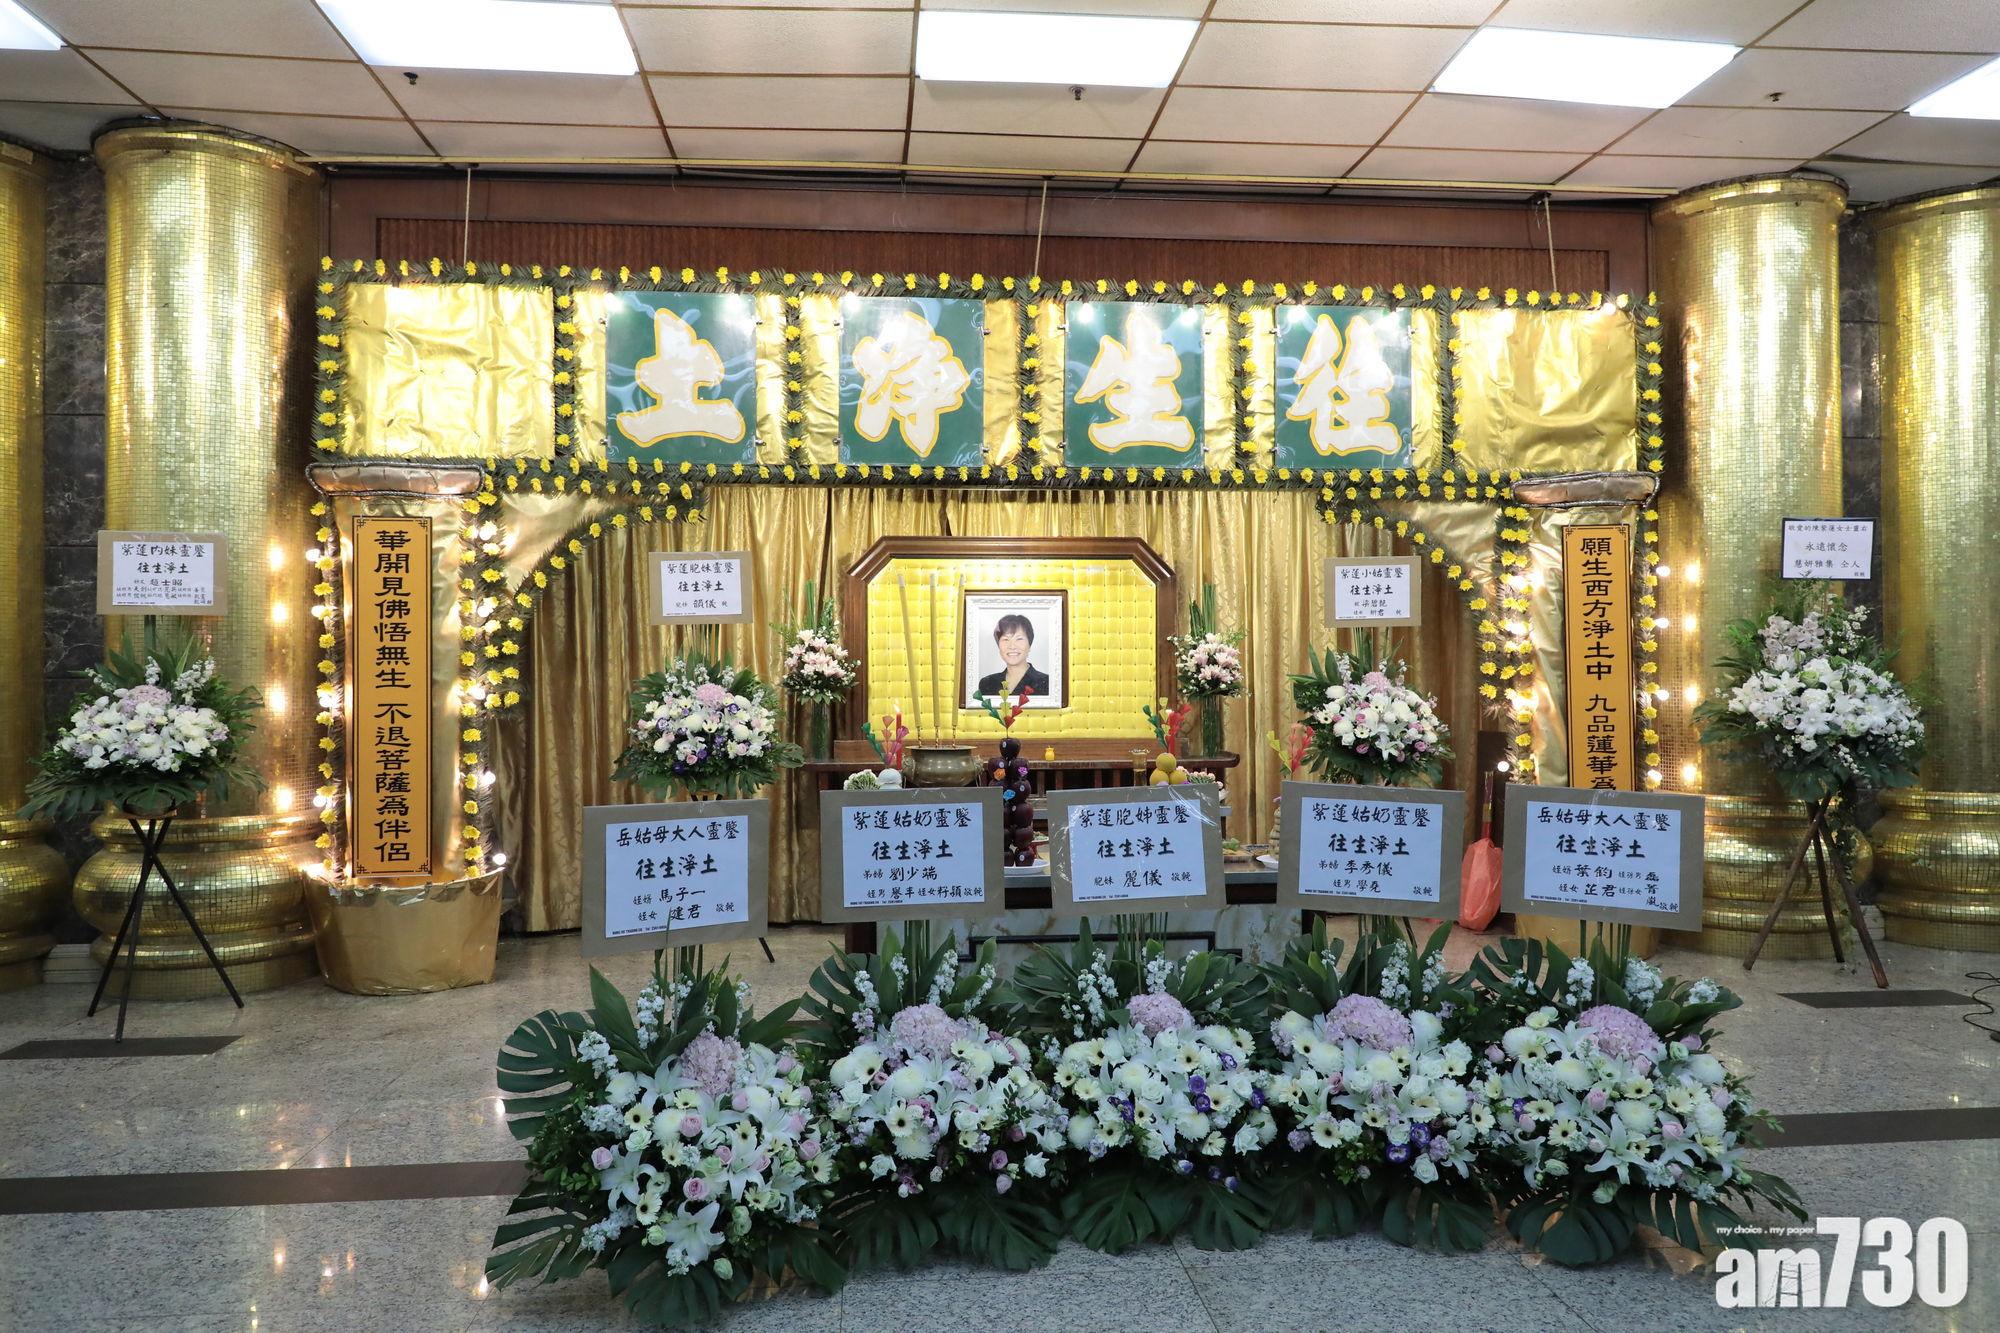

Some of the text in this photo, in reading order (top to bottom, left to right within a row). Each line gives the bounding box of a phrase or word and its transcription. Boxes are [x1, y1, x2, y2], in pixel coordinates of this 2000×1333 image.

[617, 308, 745, 446] 土
[1075, 310, 1196, 450] 生
[1286, 313, 1400, 453] 往
[1805, 541, 1848, 552] 永遠懷念
[137, 561, 189, 574] 往生淨土
[677, 579, 724, 592] 往生淨土
[1350, 583, 1394, 596] 往生淨土
[373, 530, 412, 689] 華開見佛悟無生
[1580, 537, 1615, 681] 願生西方淨土中
[853, 807, 972, 831] 紫蓮姑奶靈鑒
[1312, 802, 1431, 827] 紫蓮姑奶靈鑒
[616, 820, 740, 847] 岳姑母大人靈鑒
[1328, 833, 1410, 856] 往生淨土
[871, 838, 954, 861] 往生淨土
[1097, 836, 1175, 859] 往生淨土
[1555, 833, 1646, 859] 往生淨土
[635, 853, 718, 881] 往生淨土
[1123, 868, 1163, 888] 麗儀
[1344, 859, 1393, 877] 李秀儀
